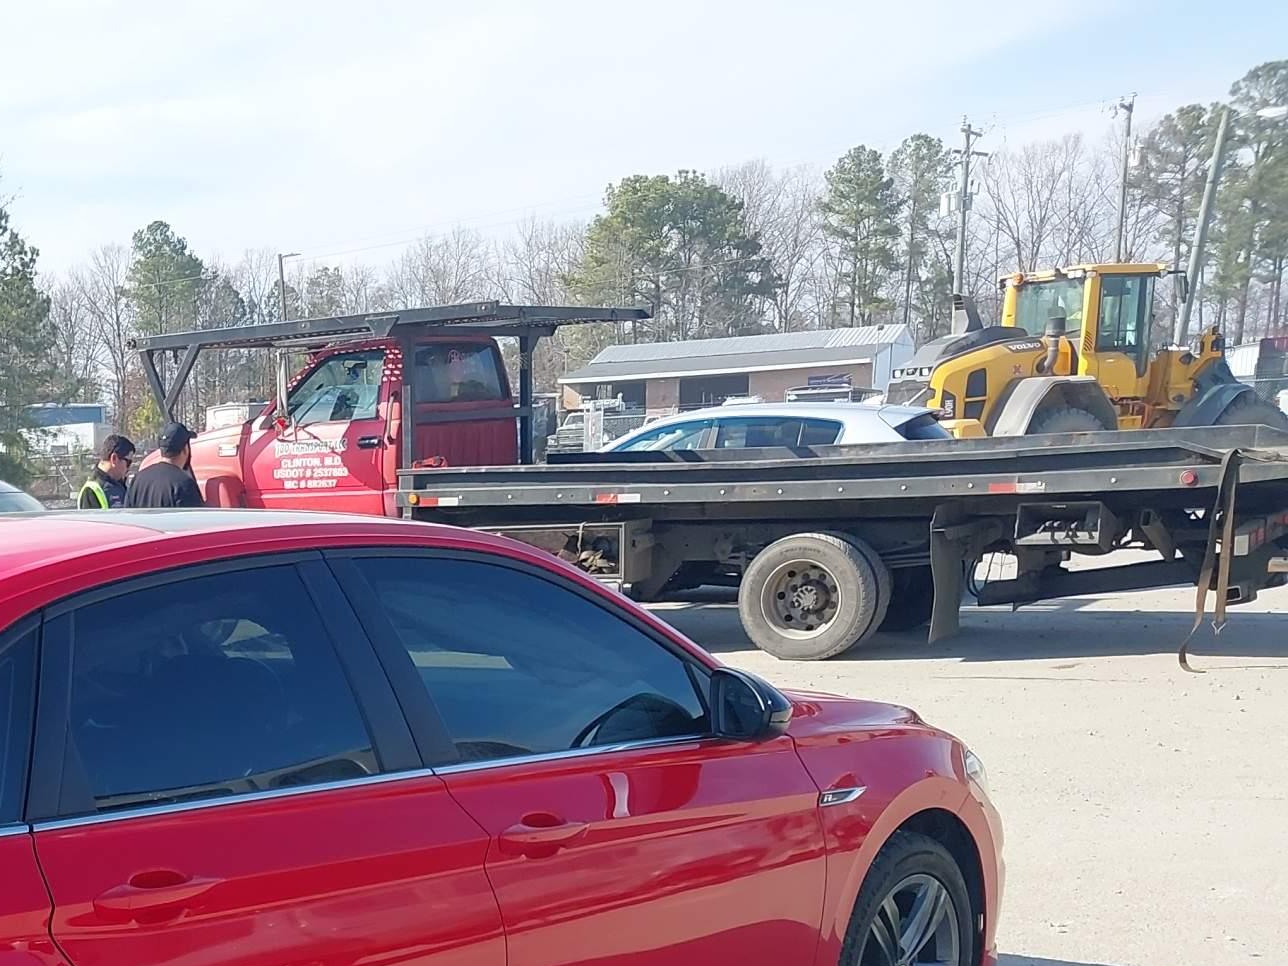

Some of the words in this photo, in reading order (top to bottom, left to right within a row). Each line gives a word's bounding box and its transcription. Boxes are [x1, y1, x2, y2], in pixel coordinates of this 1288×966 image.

[1008, 342, 1041, 351] VOLVO
[273, 468, 304, 479] USDOT
[305, 468, 312, 478] #
